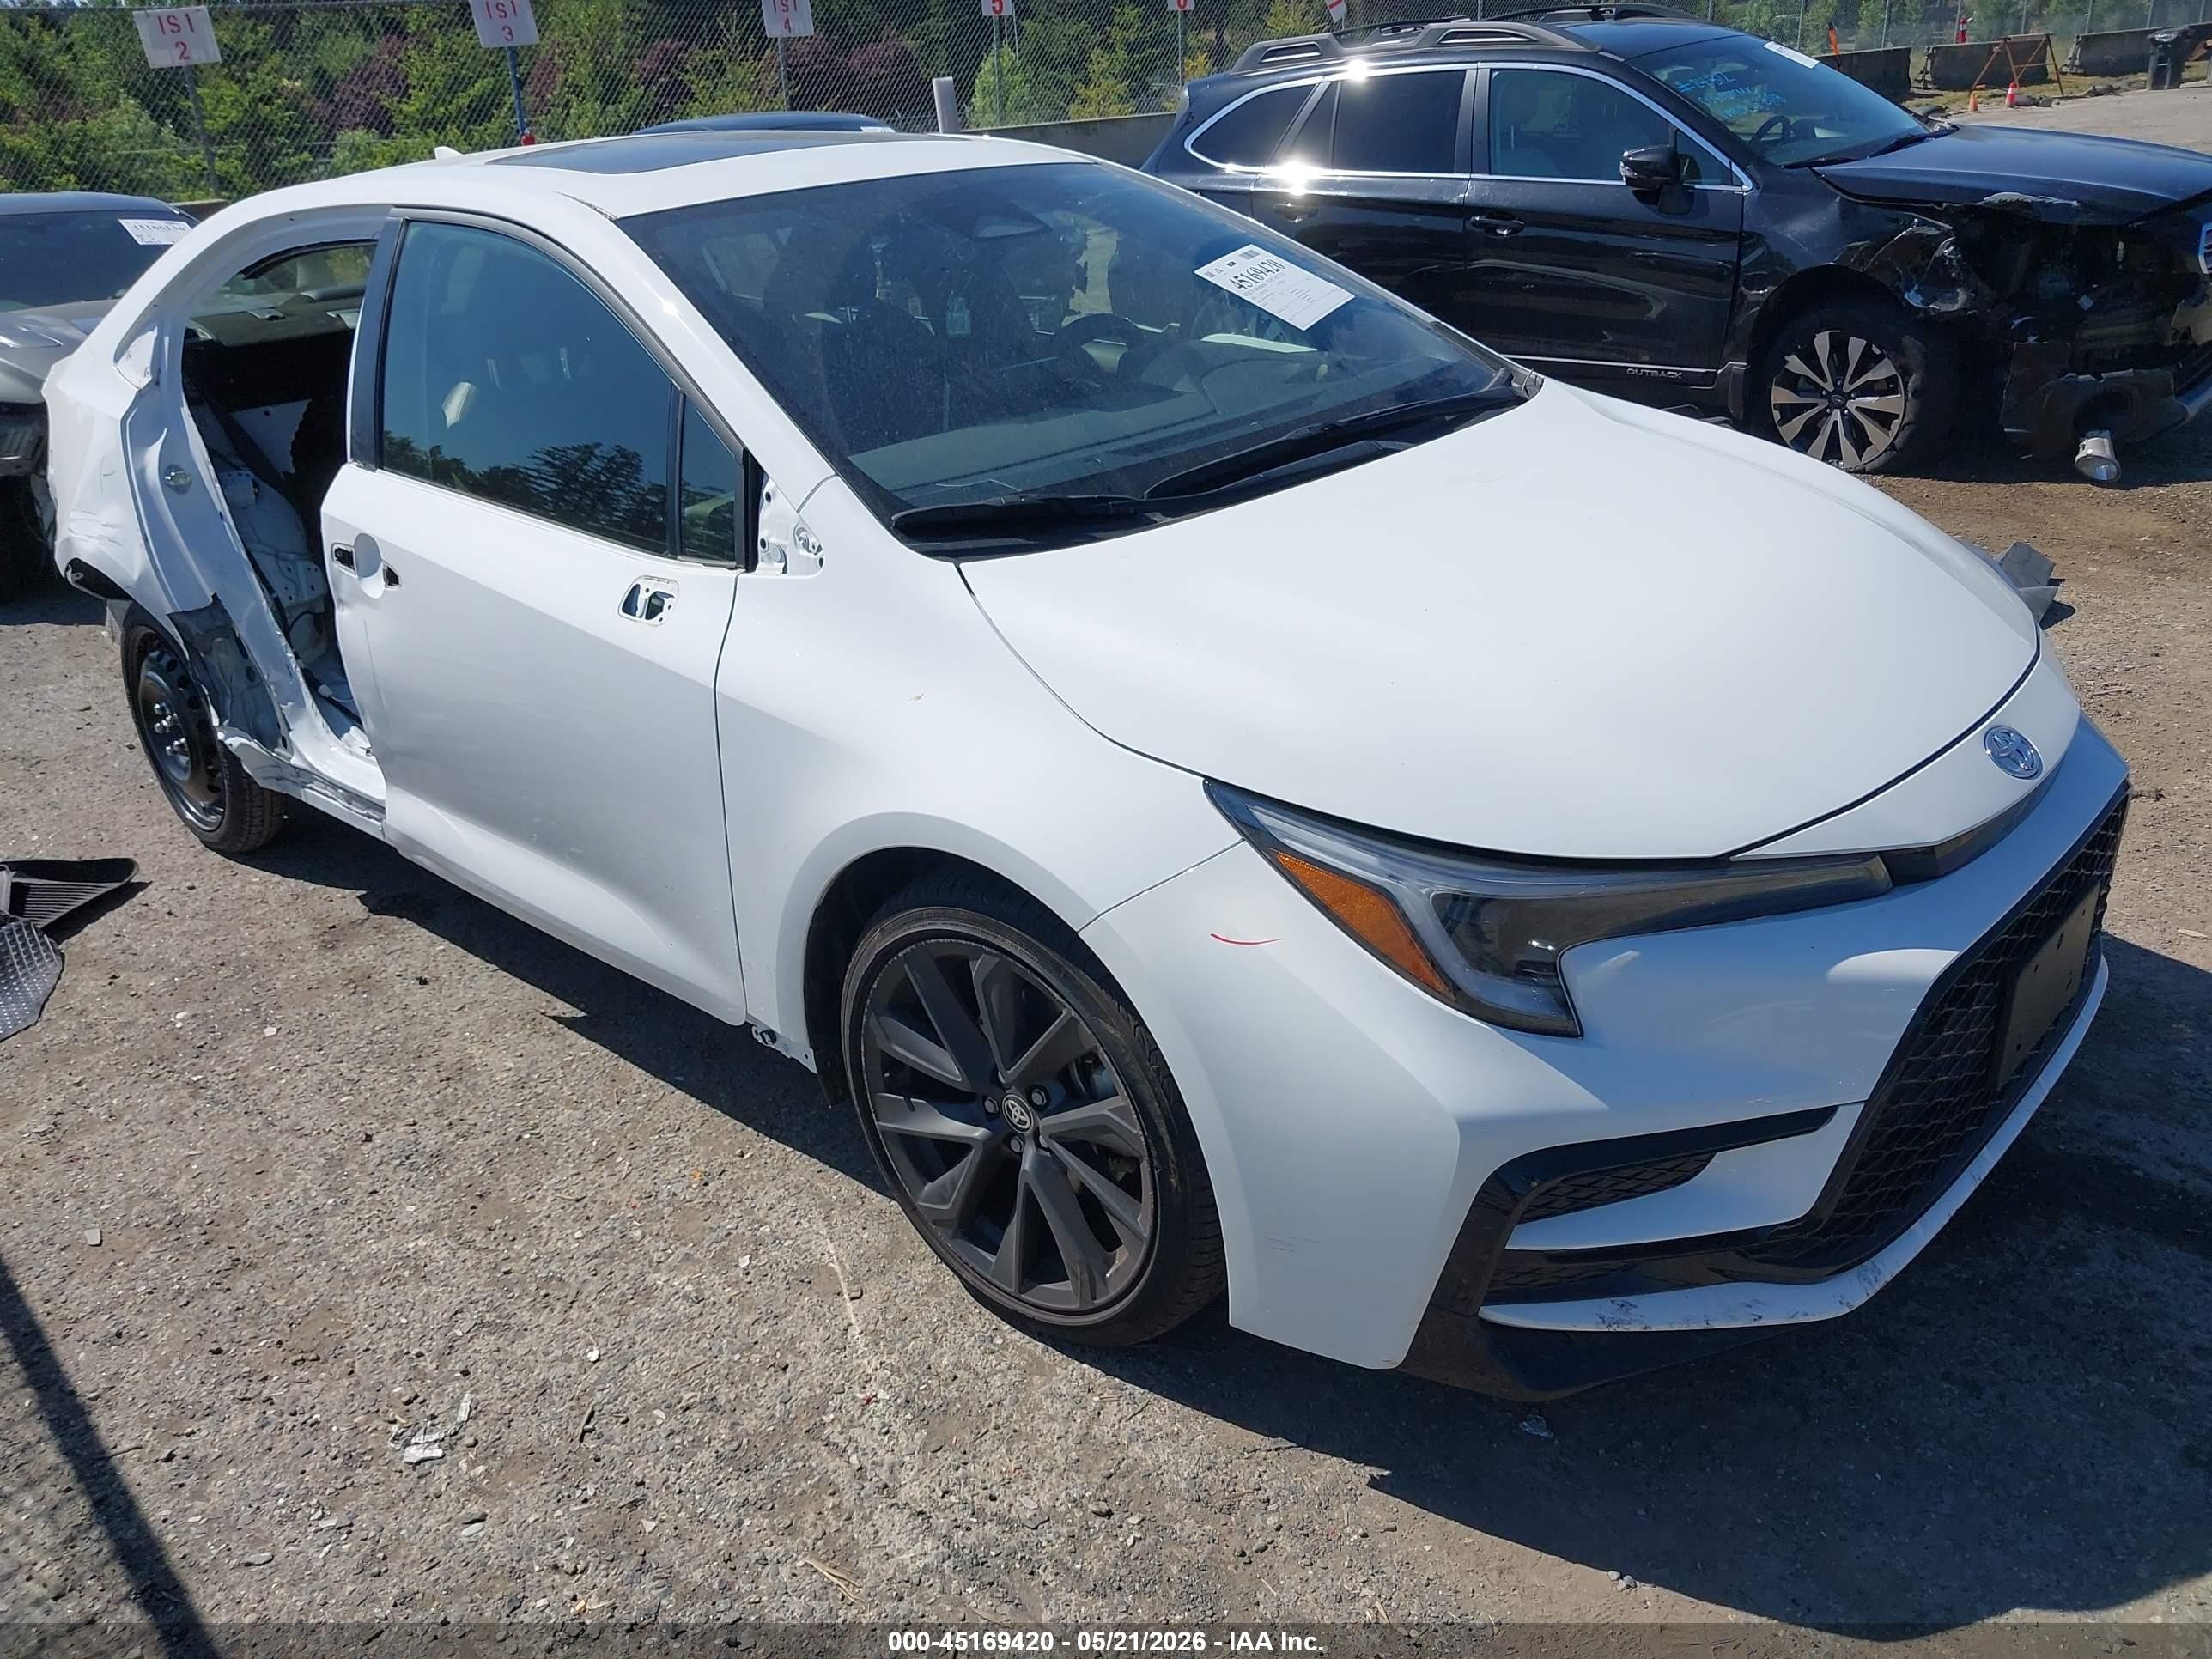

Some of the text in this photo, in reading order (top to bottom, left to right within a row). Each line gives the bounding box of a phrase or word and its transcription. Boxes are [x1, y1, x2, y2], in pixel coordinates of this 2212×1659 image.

[502, 24, 515, 42] 3
[783, 17, 792, 33] 4
[174, 40, 191, 61] 2
[1229, 258, 1286, 290] 45169420
[1626, 368, 1683, 379] OUTBACK
